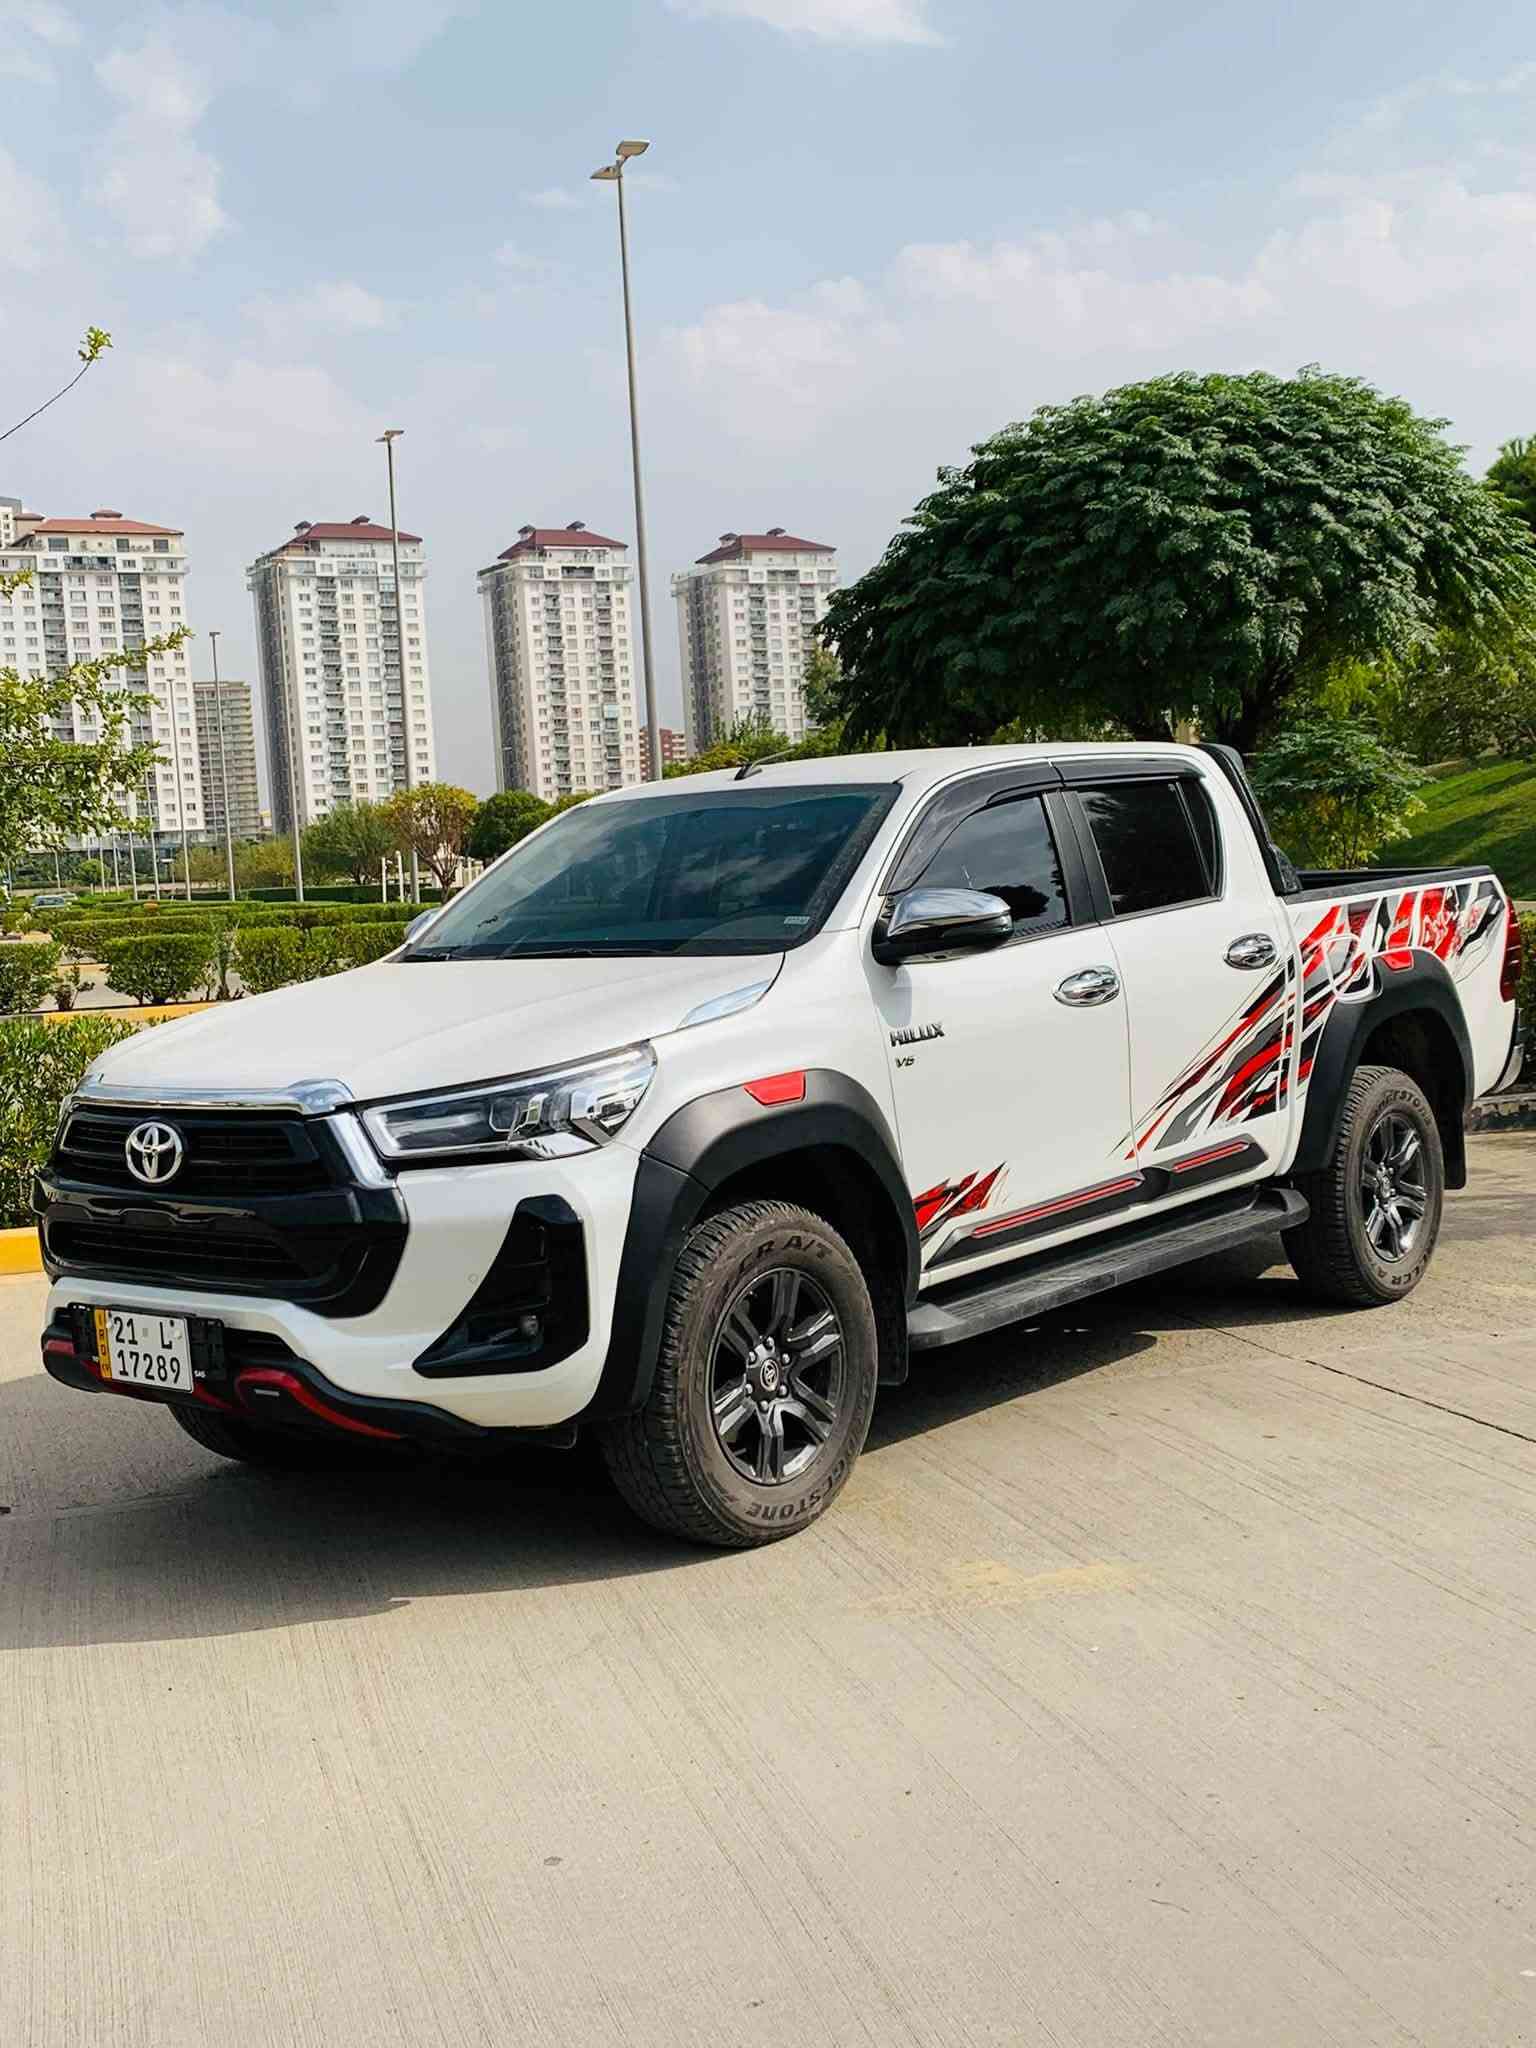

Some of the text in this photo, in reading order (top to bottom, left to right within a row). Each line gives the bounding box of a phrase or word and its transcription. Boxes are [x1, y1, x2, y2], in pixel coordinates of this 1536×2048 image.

[889, 1022, 945, 1047] HILUX
[114, 1316, 173, 1350] 21 L
[117, 1349, 181, 1385] 17289
